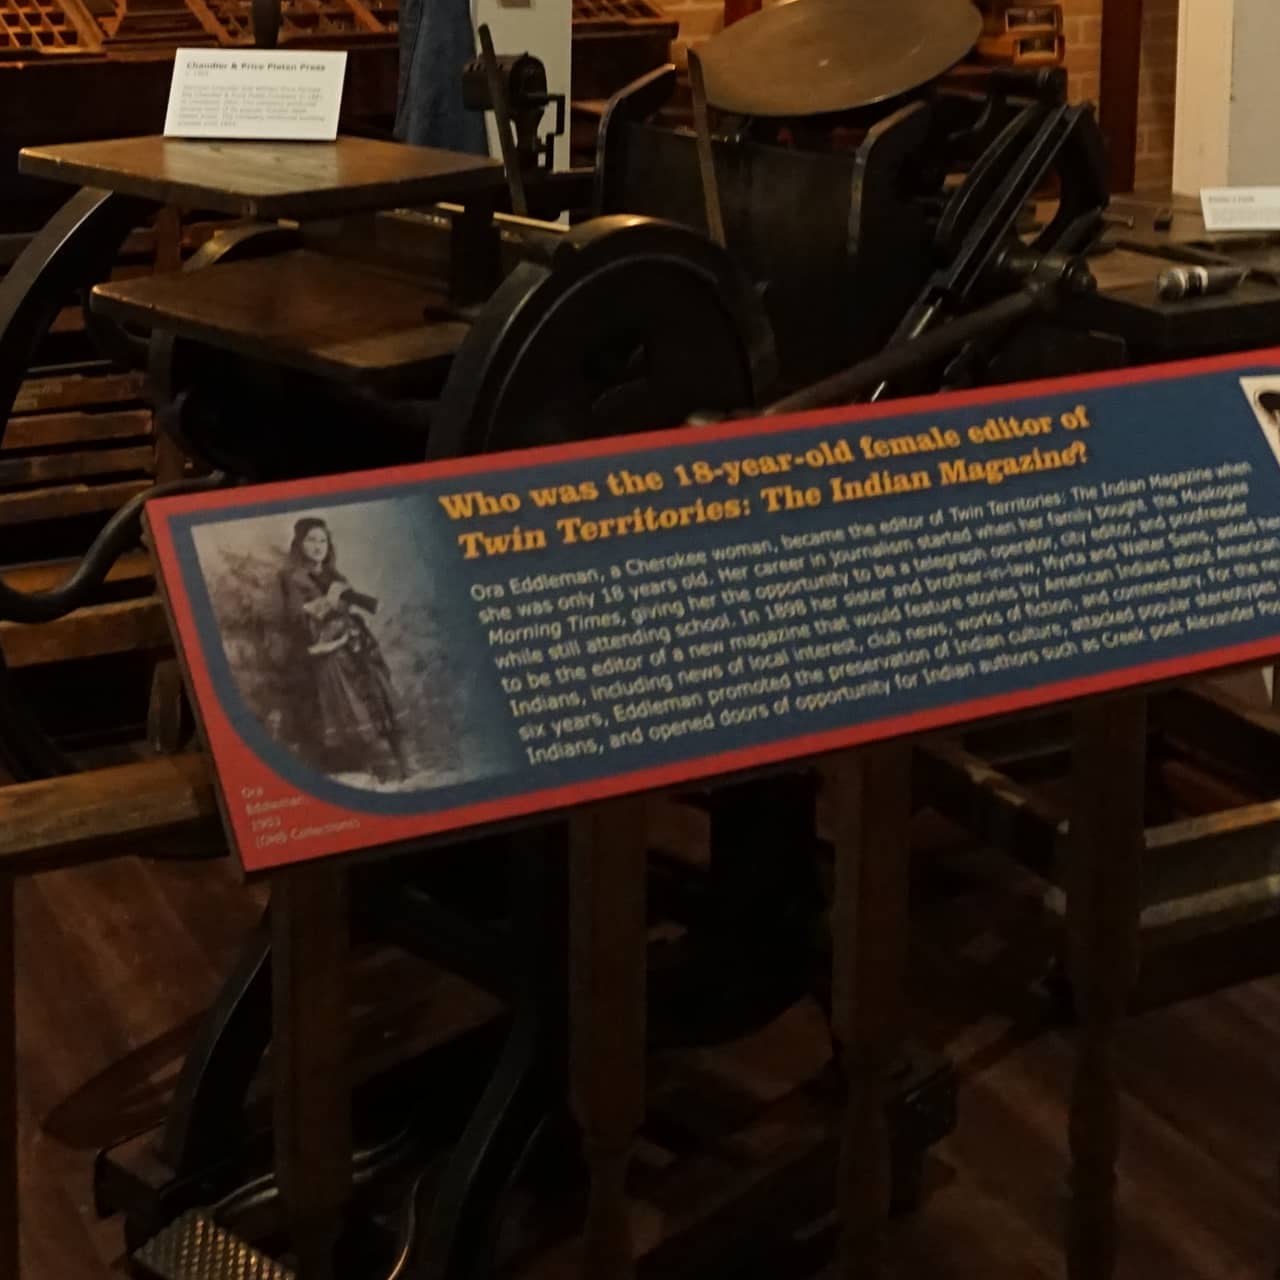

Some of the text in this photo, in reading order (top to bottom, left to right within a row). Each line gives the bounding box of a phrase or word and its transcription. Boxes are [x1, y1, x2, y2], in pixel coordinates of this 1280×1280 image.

[438, 405, 1089, 518] Who was the 18-year-old female editor of
[457, 442, 1086, 558] Twin Territories: The Indian Magazine?
[469, 583, 504, 600] Ora
[609, 565, 621, 578] a
[625, 551, 707, 575] Cherokee
[711, 540, 778, 560] woman,
[780, 529, 845, 549] became
[847, 523, 876, 538] the
[878, 515, 924, 534] editor
[928, 508, 943, 526] of
[949, 505, 983, 523] Twin
[986, 493, 1065, 517] Territories:
[1070, 486, 1100, 504] The
[1100, 478, 1146, 498] Indian
[1148, 468, 1214, 490] Magazine
[1214, 461, 1252, 478] when
